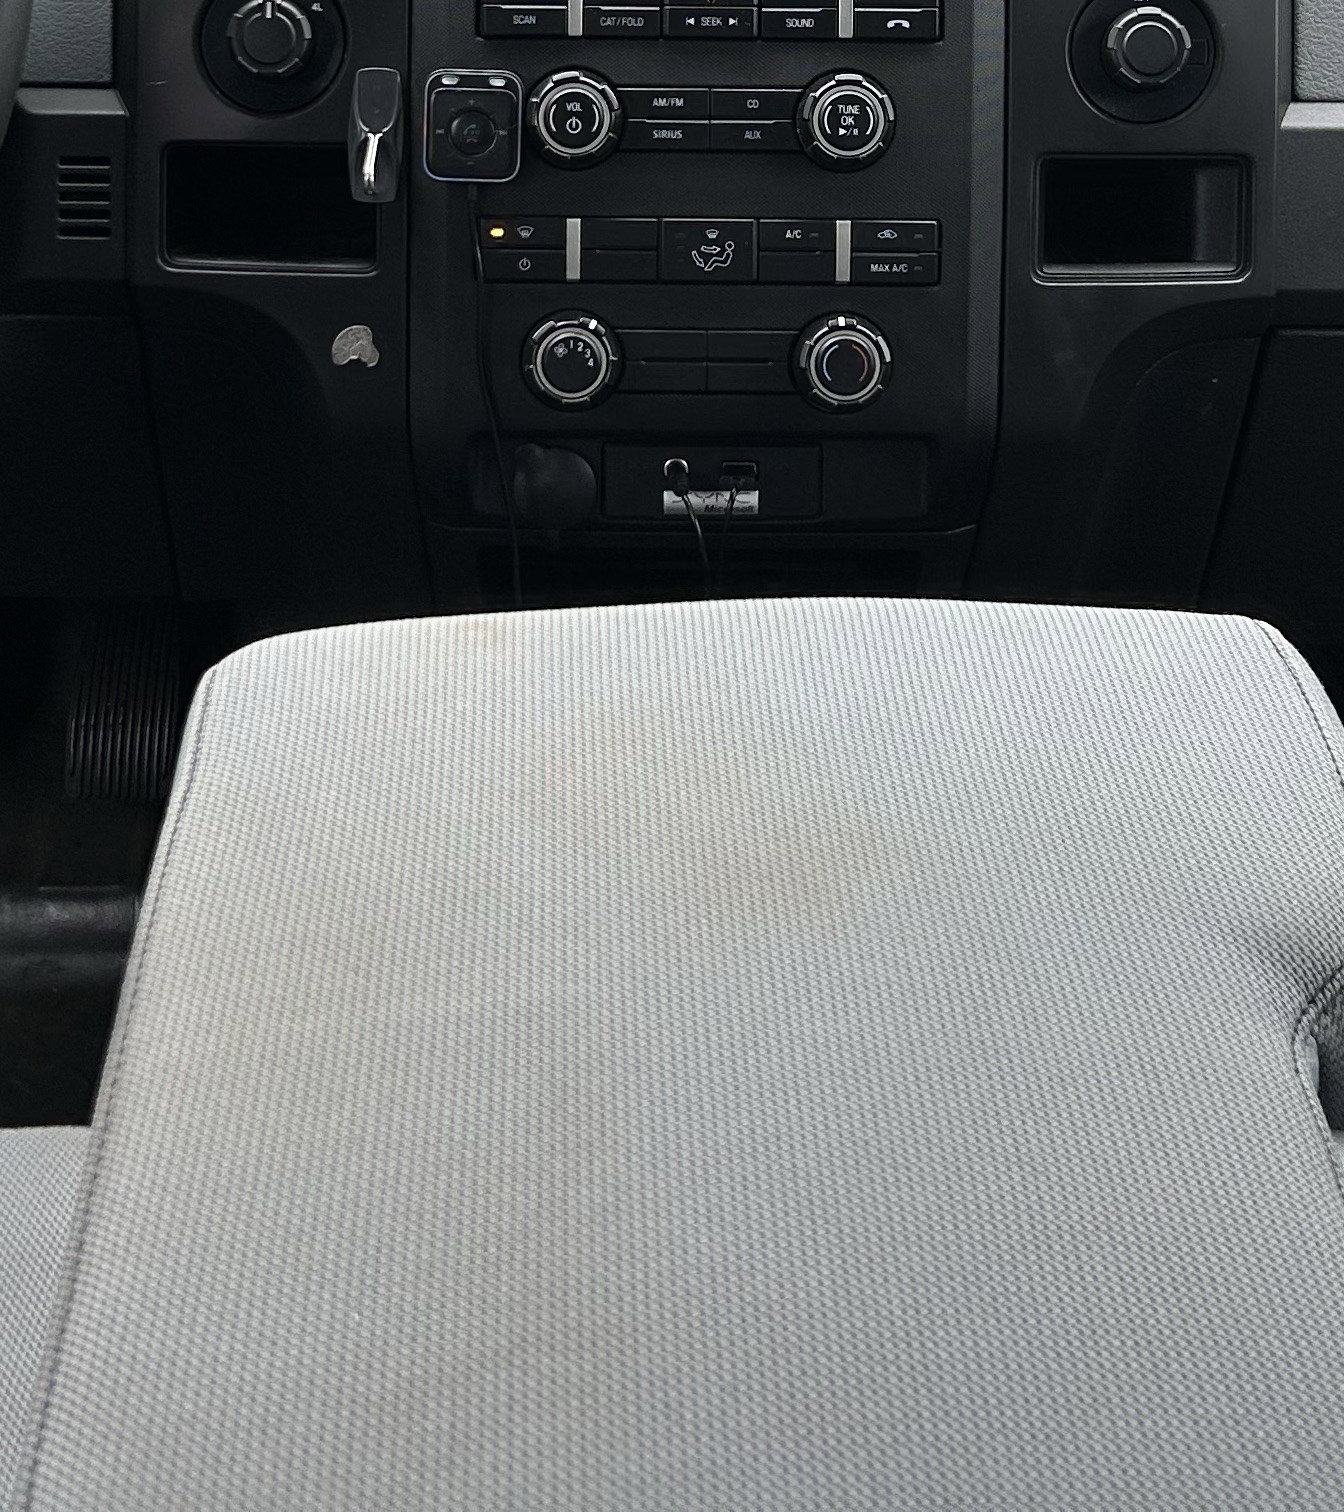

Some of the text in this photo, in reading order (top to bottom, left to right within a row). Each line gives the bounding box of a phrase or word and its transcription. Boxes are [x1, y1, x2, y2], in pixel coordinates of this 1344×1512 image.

[311, 2, 324, 12] 4L
[512, 14, 537, 25] SCAN
[599, 16, 645, 27] CAT/FOLD
[700, 16, 723, 27] SEEK
[785, 17, 815, 28] SOUND
[565, 101, 583, 112] VOL
[652, 97, 685, 107] AM/FM
[746, 98, 760, 109] CD
[837, 104, 861, 115] TUNE
[840, 115, 855, 126] OK
[652, 129, 683, 139] SIRIUS
[743, 130, 762, 140] AUX
[785, 229, 802, 239] A/C
[870, 263, 909, 273] MAX A/C
[577, 341, 584, 352] 2
[584, 348, 592, 358] 3
[586, 357, 594, 367] 4
